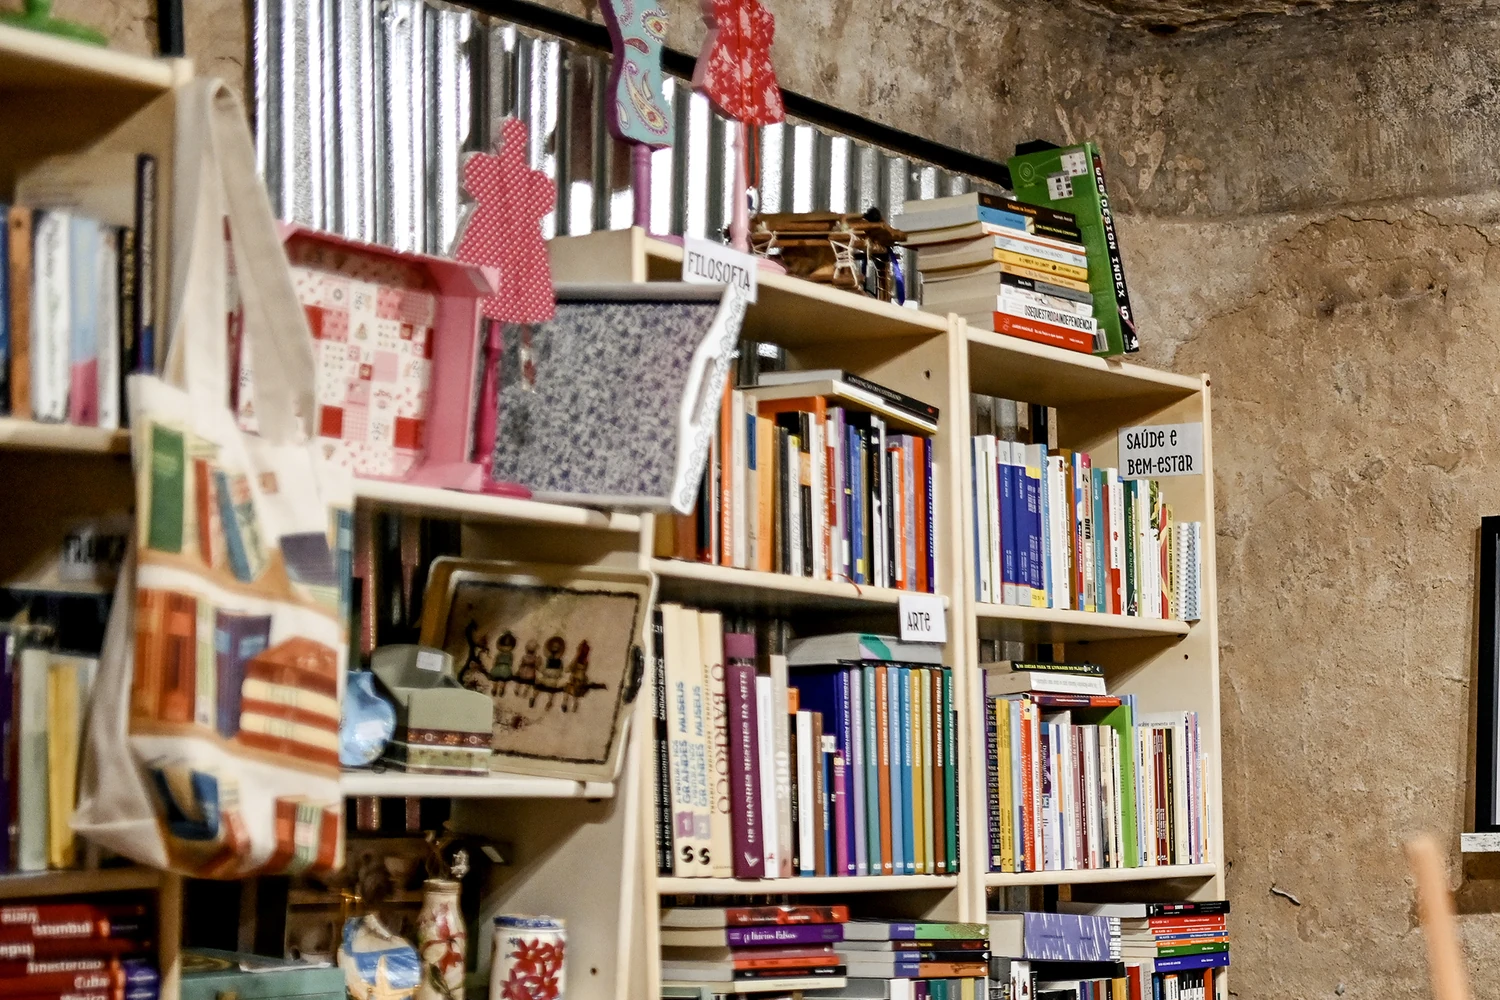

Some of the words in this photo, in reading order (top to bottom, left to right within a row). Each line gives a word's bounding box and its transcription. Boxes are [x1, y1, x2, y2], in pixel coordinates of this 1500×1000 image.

[1094, 167, 1104, 193] WEB
[1101, 199, 1116, 250] DESIGN
[1111, 256, 1125, 298] INDEX
[1121, 305, 1129, 320] 5
[723, 489, 731, 557] KIERKEGAARD
[675, 681, 687, 733] MUSEUS
[740, 671, 748, 700] ARTE
[679, 740, 691, 804] GRANDES
[712, 692, 732, 815] BARROCO
[744, 721, 752, 771] MESTRES
[745, 774, 754, 826] GRANDES
[775, 750, 790, 799] 200
[776, 930, 796, 939] Falsos
[74, 975, 110, 989] Cuba
